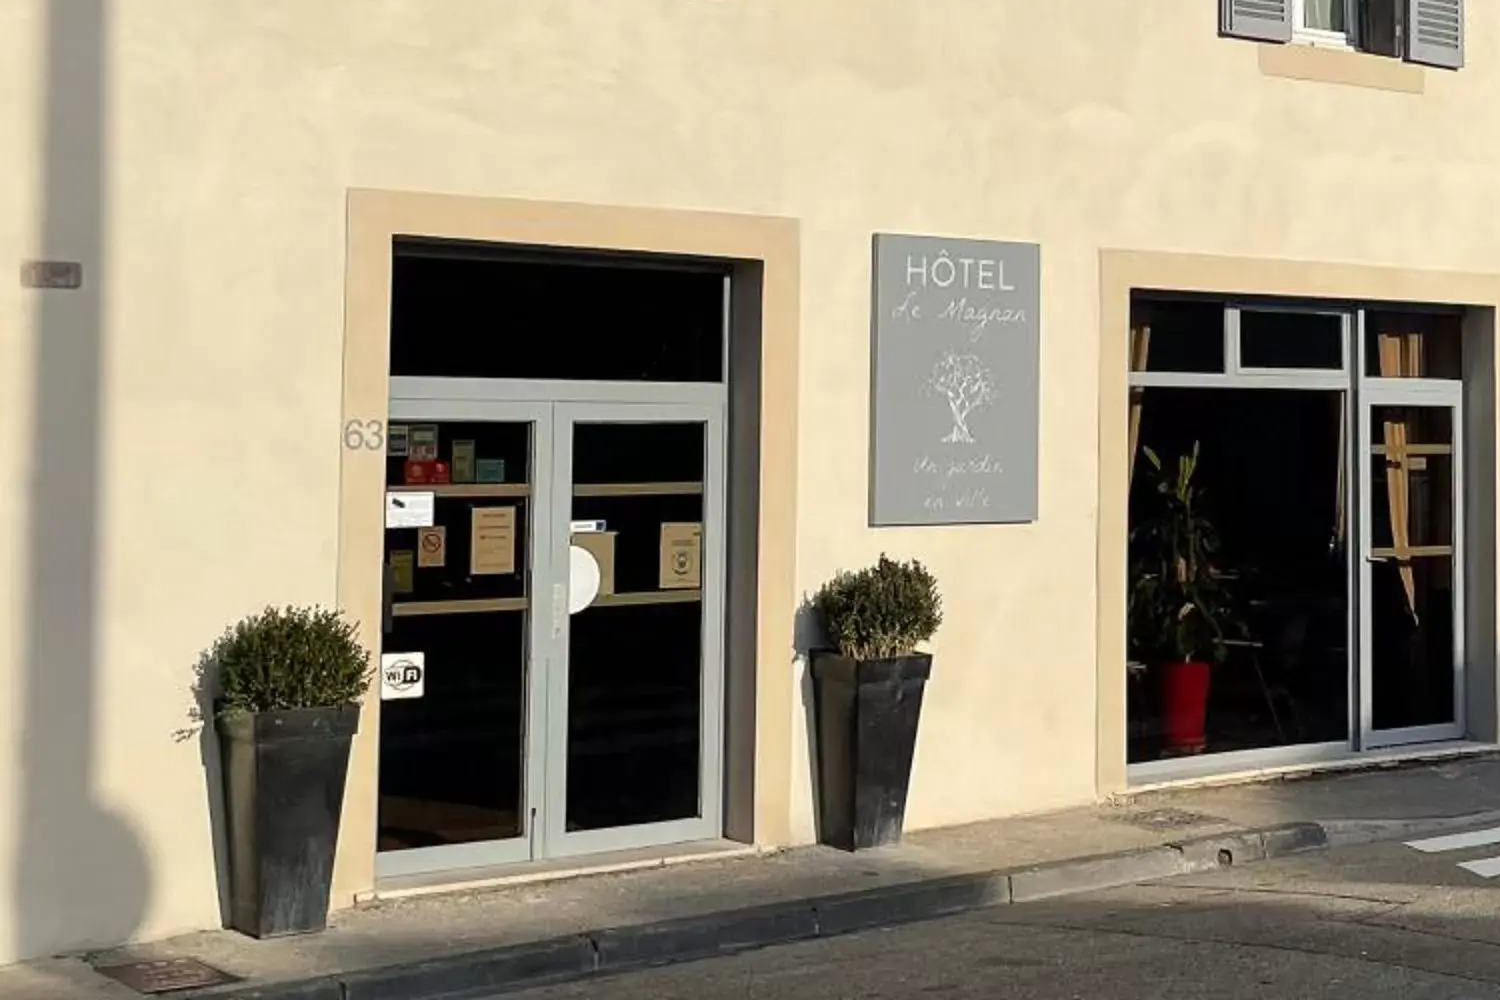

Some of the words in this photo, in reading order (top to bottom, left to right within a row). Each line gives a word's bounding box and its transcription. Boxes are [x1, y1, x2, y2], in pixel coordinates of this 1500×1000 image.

[906, 249, 1016, 291] HÔTEL
[891, 291, 921, 322] Le
[937, 296, 1027, 342] Magnan
[344, 419, 384, 450] 63
